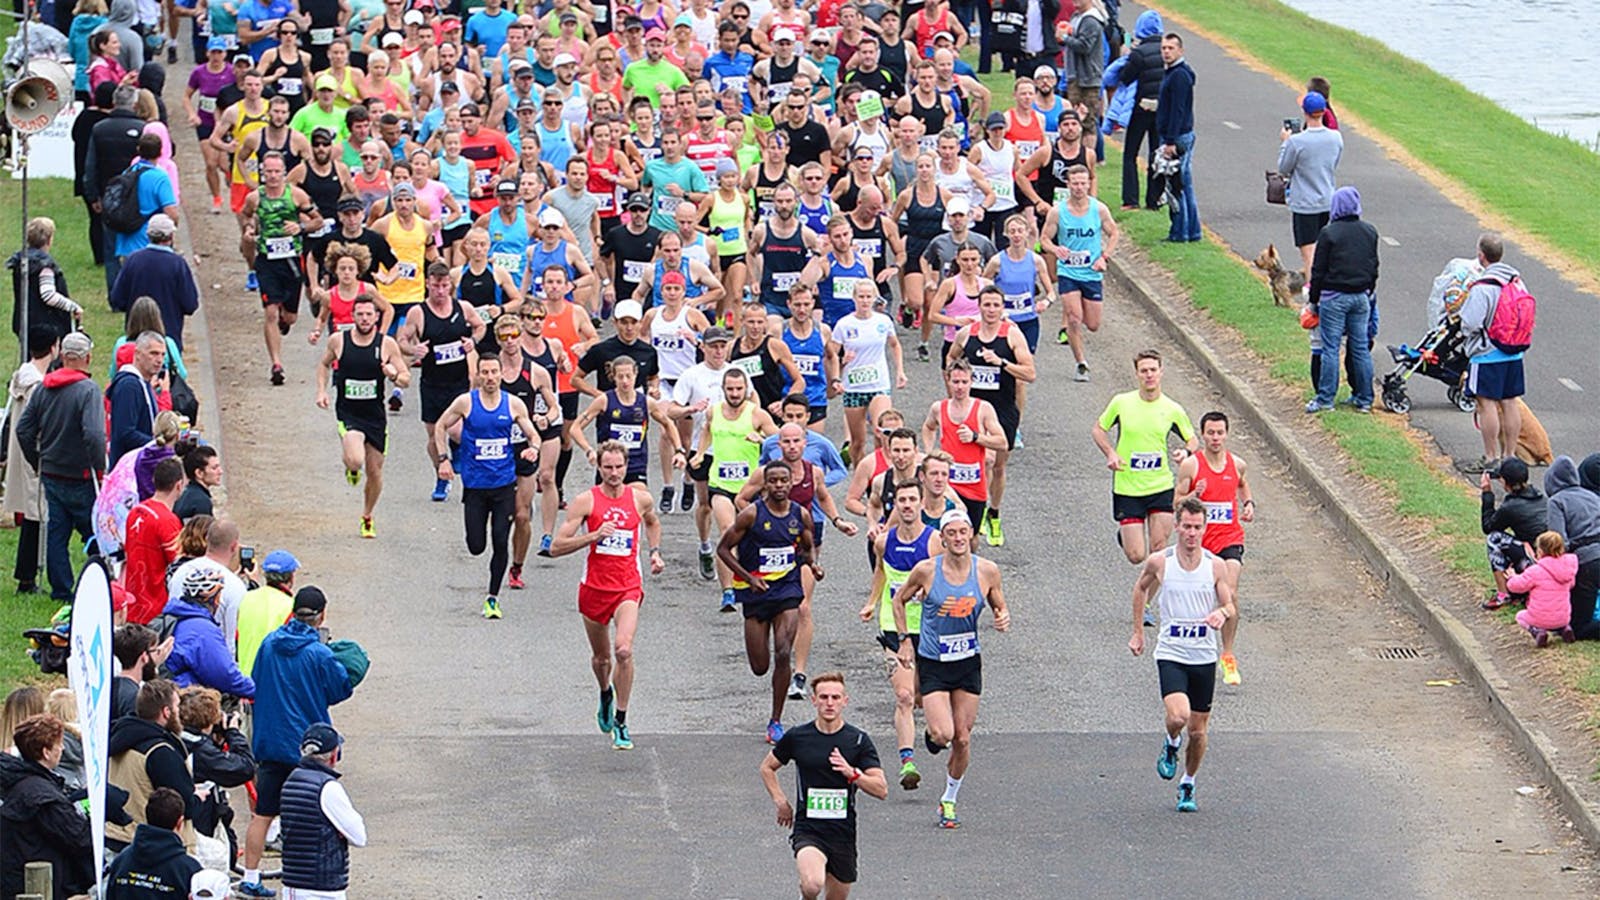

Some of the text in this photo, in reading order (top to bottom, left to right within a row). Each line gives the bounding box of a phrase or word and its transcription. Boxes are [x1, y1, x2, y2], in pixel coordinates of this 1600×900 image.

[1066, 228, 1095, 238] FILA
[974, 373, 994, 384] 370
[618, 430, 634, 442] 20
[1135, 457, 1157, 469] 477
[722, 466, 745, 478] 136
[602, 536, 628, 550] 425
[765, 553, 789, 566] 291
[1177, 625, 1199, 638] 171
[946, 640, 970, 653] 749
[811, 796, 844, 810] 1119
